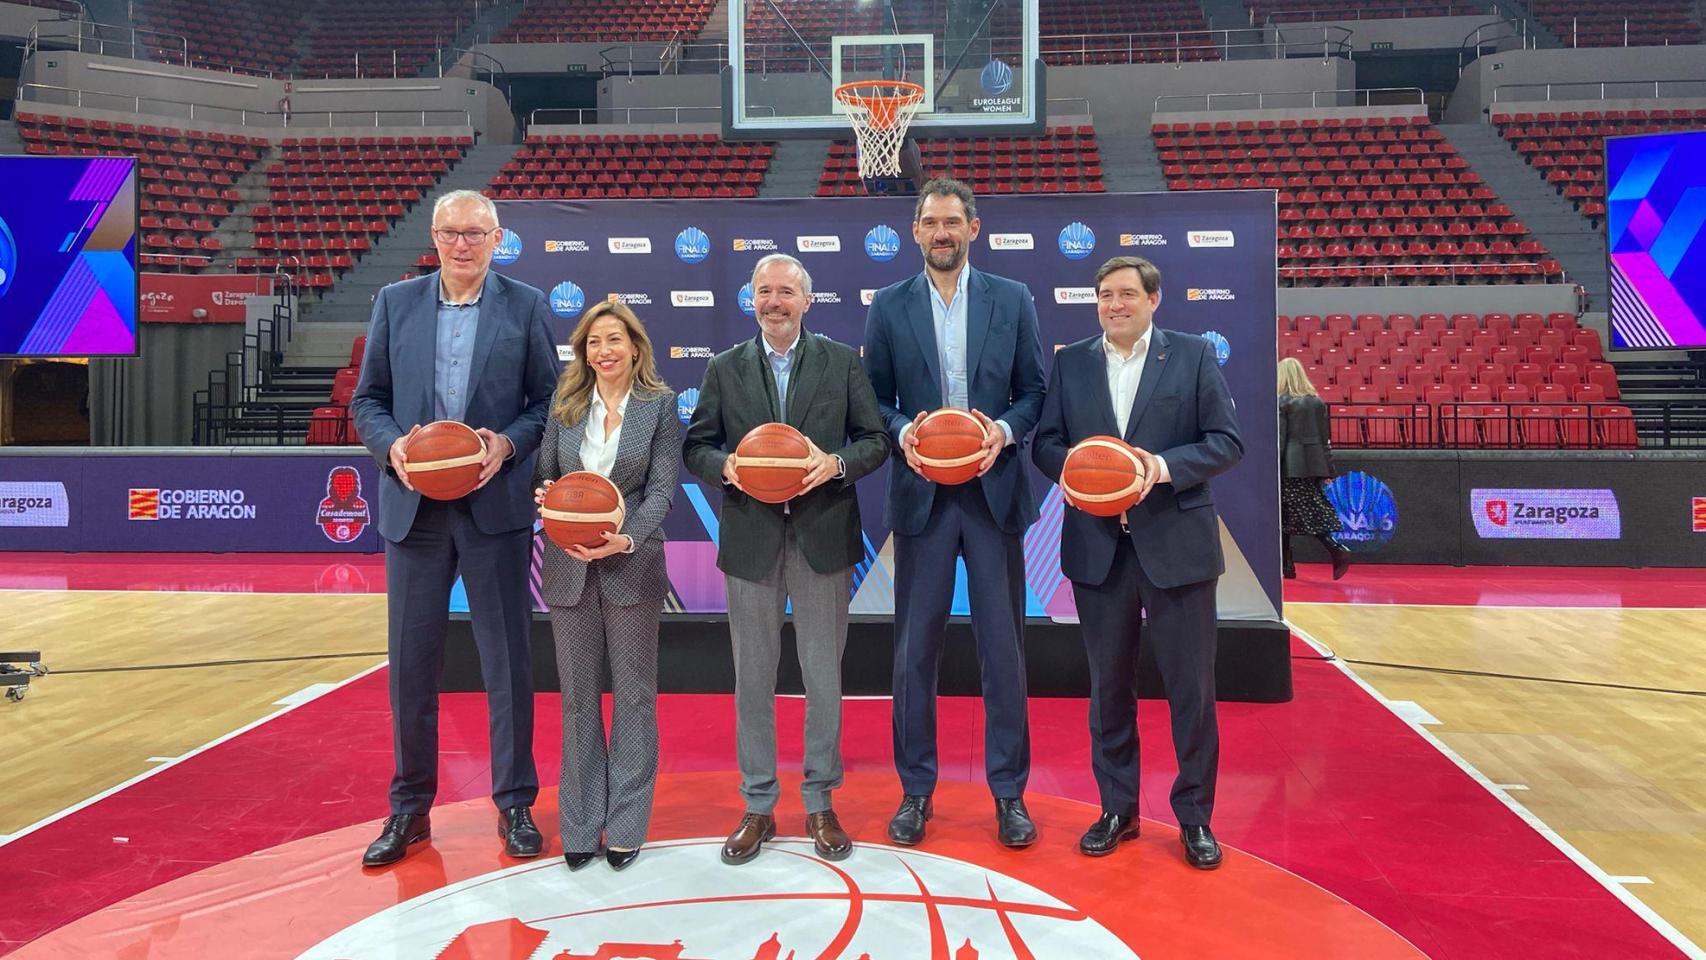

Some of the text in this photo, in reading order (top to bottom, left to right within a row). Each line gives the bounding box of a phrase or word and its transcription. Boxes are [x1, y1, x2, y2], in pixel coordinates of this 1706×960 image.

[973, 98, 1021, 106] EUROLEAGUE
[160, 490, 244, 504] GOBIERNO
[0, 497, 52, 513] ragoza
[160, 504, 256, 519] DE ARAGON
[1513, 503, 1599, 524] Zaragoza
